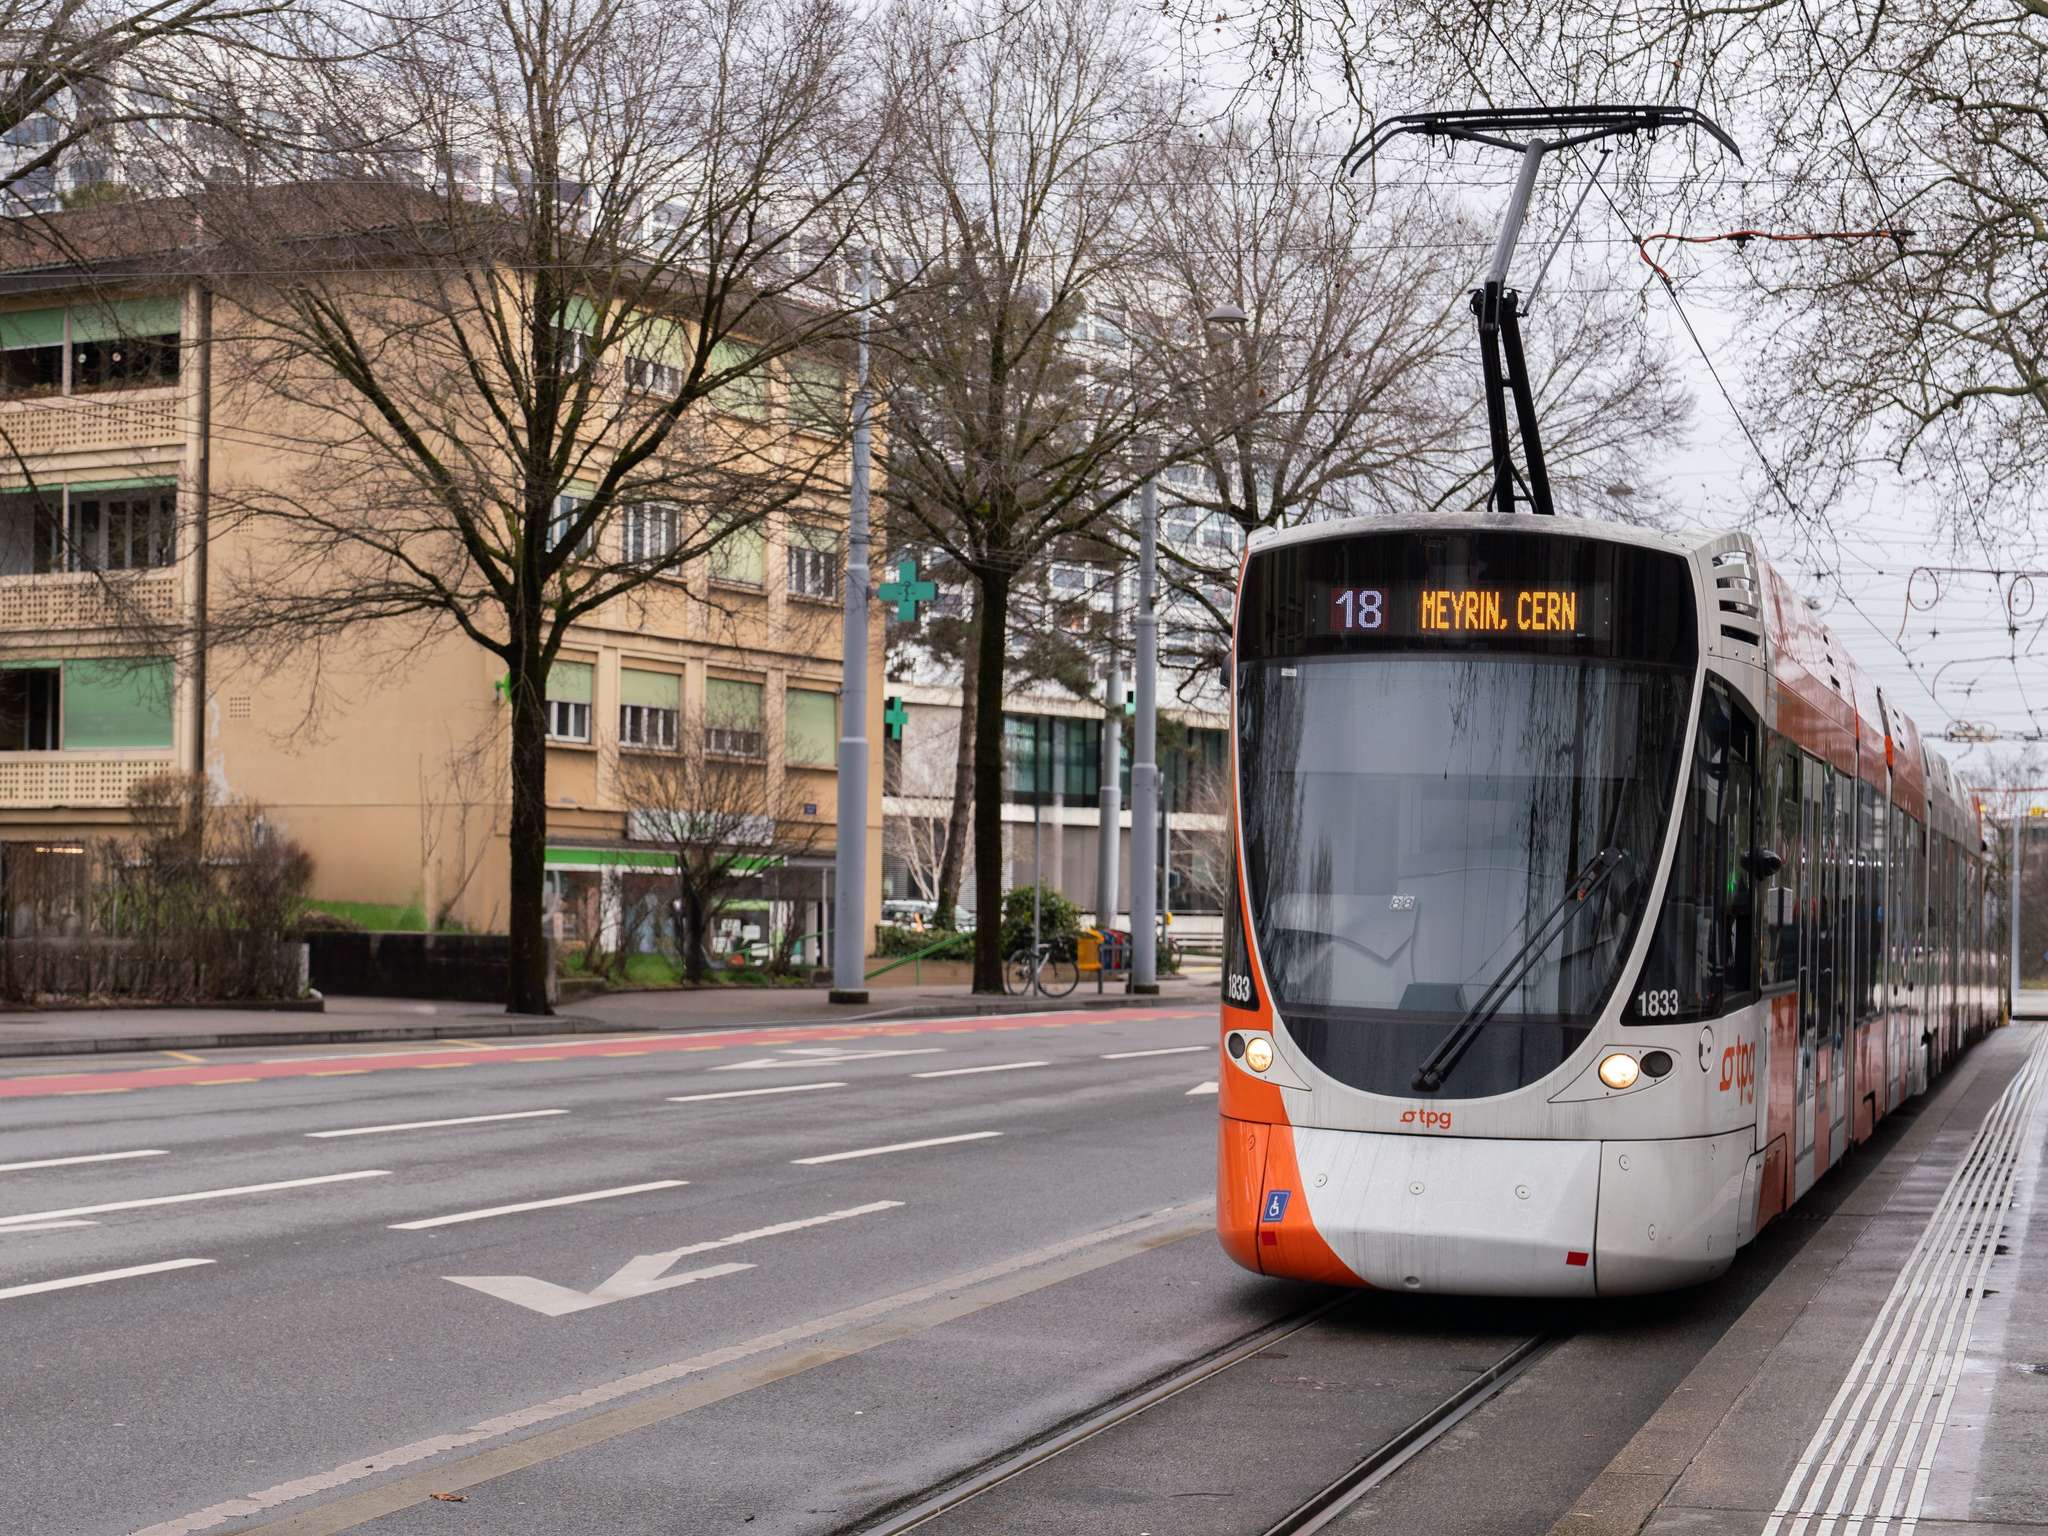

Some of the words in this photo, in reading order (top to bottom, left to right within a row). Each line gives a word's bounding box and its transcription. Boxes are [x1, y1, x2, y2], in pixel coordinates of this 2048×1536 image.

[1335, 590, 1382, 628] 18
[1421, 591, 1508, 630] MEYRIN,
[1517, 591, 1576, 630] CERN
[1228, 973, 1251, 1002] 1833
[1637, 988, 1679, 1017] 1833
[1735, 1032, 1756, 1106] tpg
[1418, 1108, 1452, 1129] tpg
